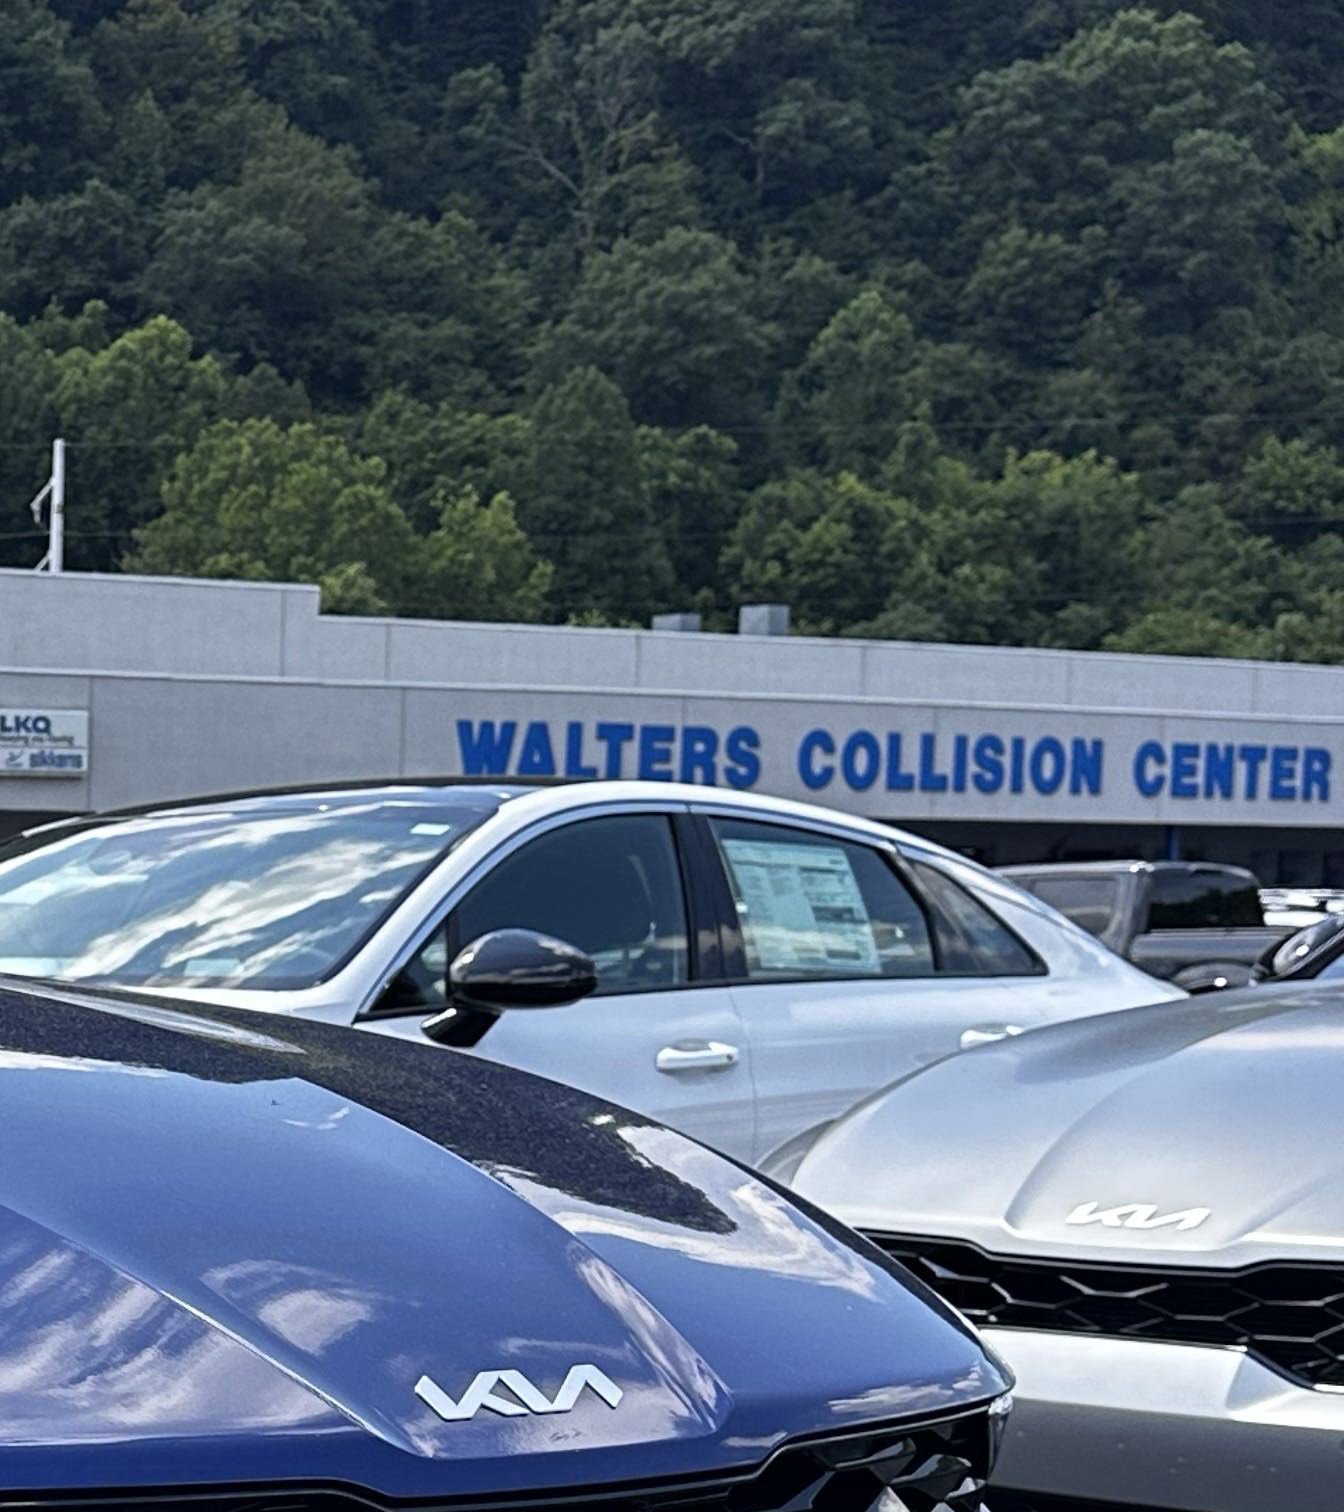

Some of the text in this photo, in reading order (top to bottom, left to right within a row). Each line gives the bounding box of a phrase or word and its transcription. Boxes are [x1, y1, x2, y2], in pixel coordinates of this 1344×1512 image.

[0, 714, 52, 736] LKQ
[456, 719, 1333, 803] WALTERS COLLISION CENTER
[1064, 1201, 1212, 1232] KIA
[414, 1363, 624, 1421] KIA
